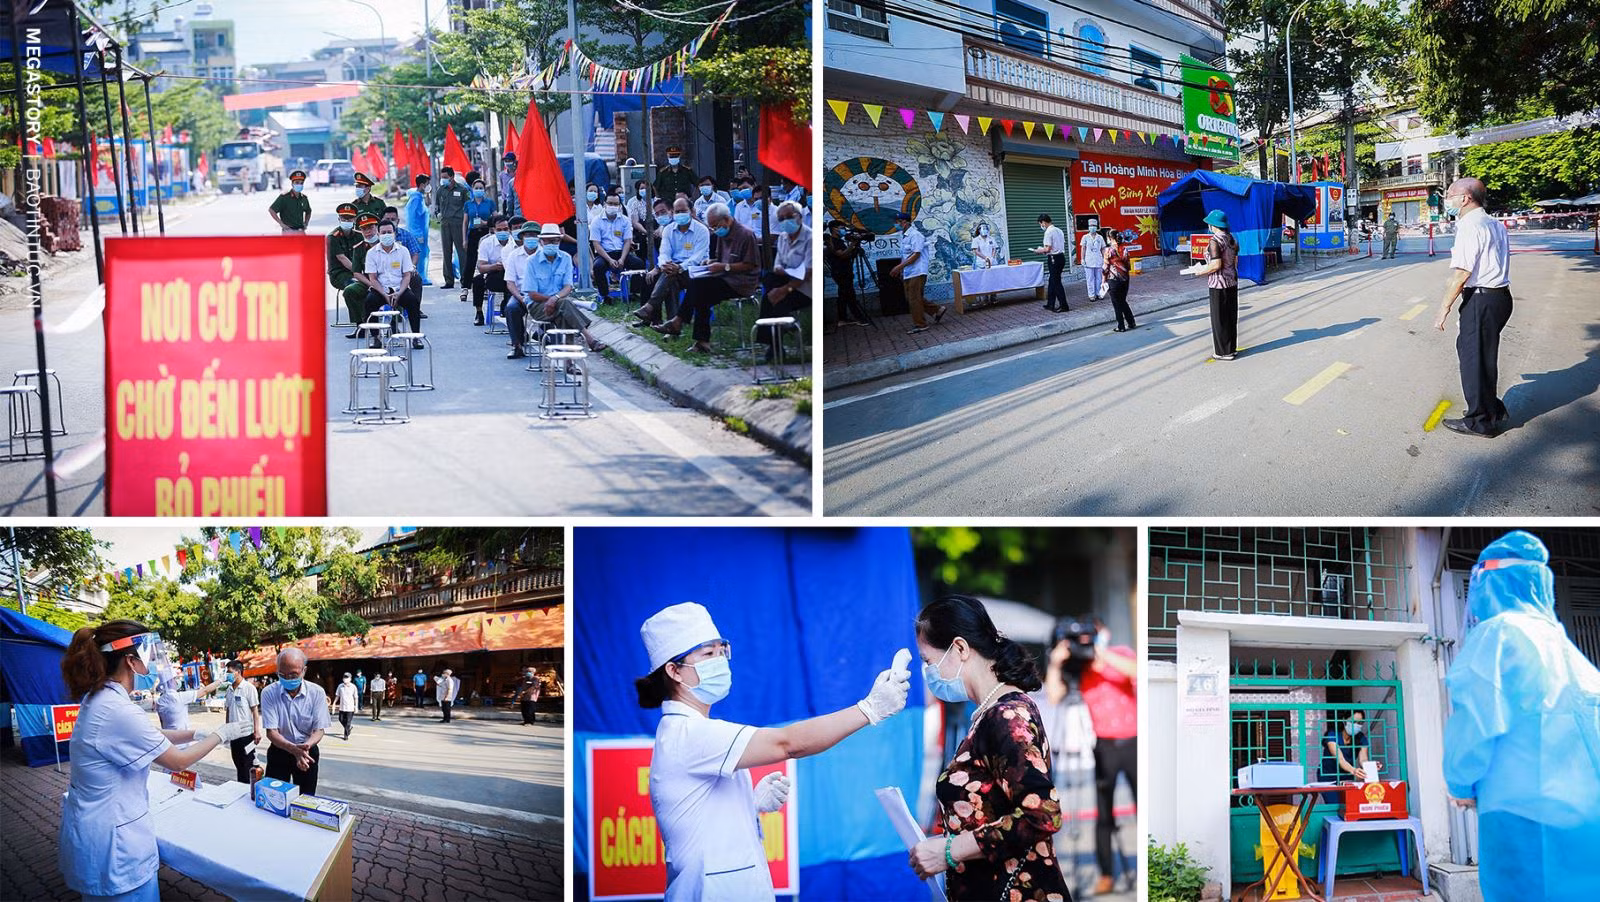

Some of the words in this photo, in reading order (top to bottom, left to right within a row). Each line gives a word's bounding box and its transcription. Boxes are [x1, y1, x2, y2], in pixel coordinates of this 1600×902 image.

[1081, 160, 1102, 174] Tân
[1104, 162, 1136, 179] Hoàng
[1137, 165, 1158, 178] Minh
[141, 278, 191, 342] NƠI
[198, 256, 242, 342] CỬ
[243, 281, 289, 341] TRI
[116, 363, 176, 440] CHỜ
[180, 358, 239, 439] ĐẾN
[246, 372, 315, 452] LƯỢT
[155, 452, 194, 506] BỎ
[201, 454, 285, 506] PHIẾU
[1193, 678, 1212, 691] 46
[601, 806, 657, 867] CÁCH
